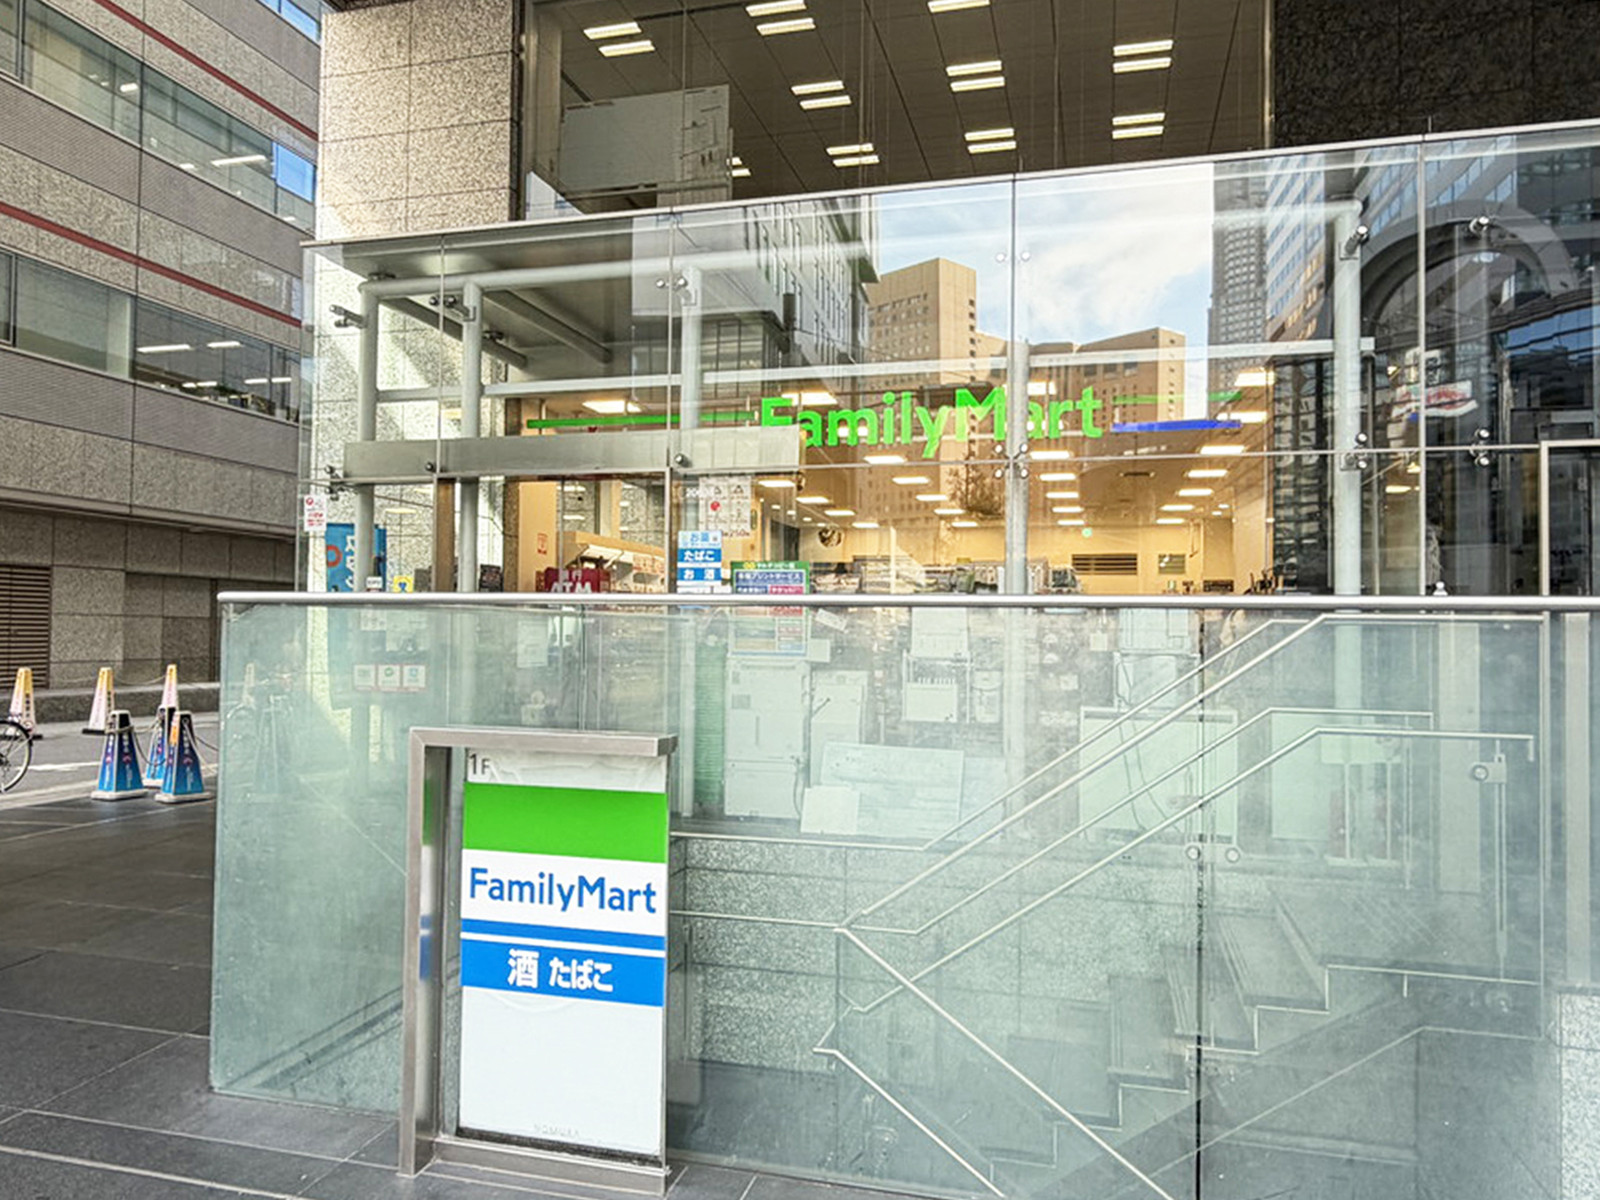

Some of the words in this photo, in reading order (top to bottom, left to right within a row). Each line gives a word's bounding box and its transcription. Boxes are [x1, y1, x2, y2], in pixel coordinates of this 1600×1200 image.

[761, 385, 1103, 459] FamilyMart
[683, 550, 715, 562] たばこ
[469, 753, 491, 775] 1F
[469, 866, 657, 914] FamilyMart
[507, 948, 540, 989] 酒
[549, 957, 614, 993] たばこ
